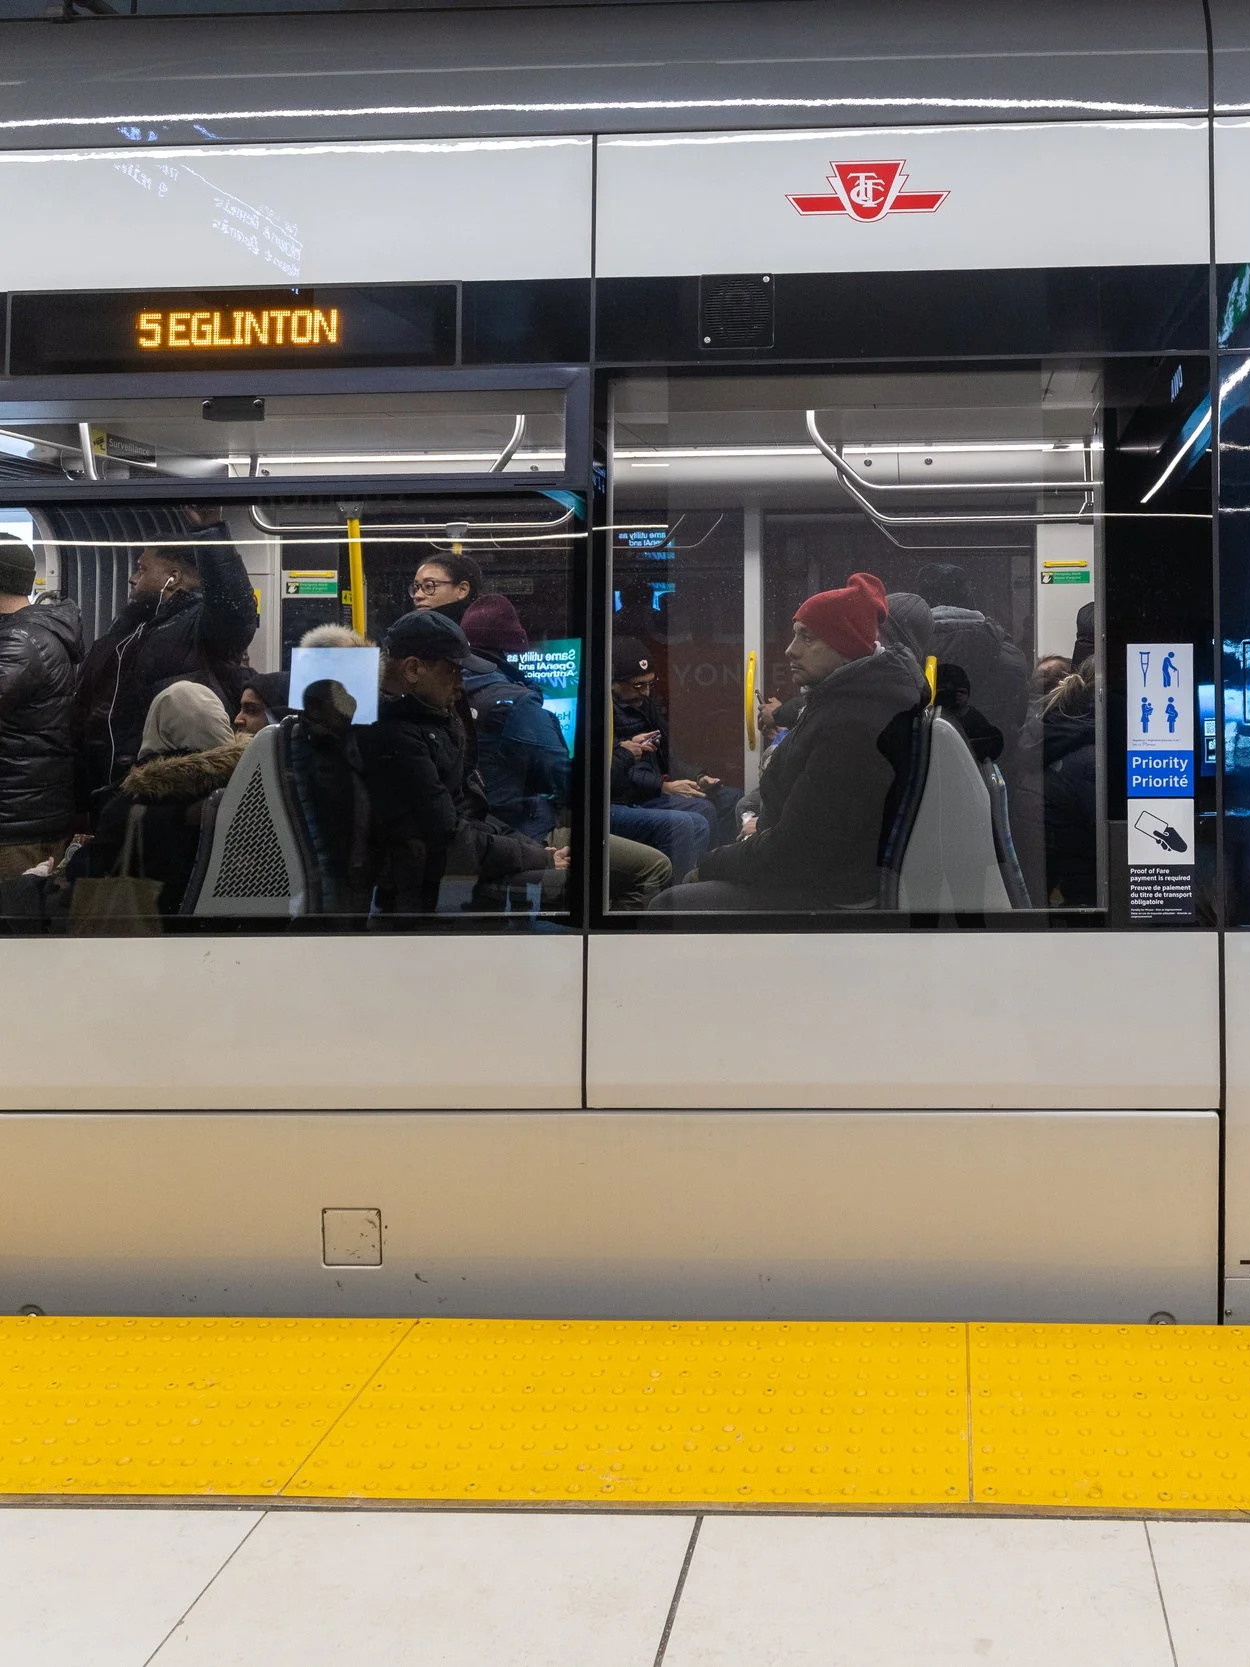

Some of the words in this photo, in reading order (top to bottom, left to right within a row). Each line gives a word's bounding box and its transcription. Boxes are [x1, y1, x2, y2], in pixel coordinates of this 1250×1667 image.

[139, 313, 162, 347] 5
[169, 309, 338, 346] EGLINTON
[109, 439, 150, 456] Surveillance
[672, 663, 786, 687] YONE
[1132, 757, 1188, 772] Priority
[1132, 775, 1188, 788] Priorité
